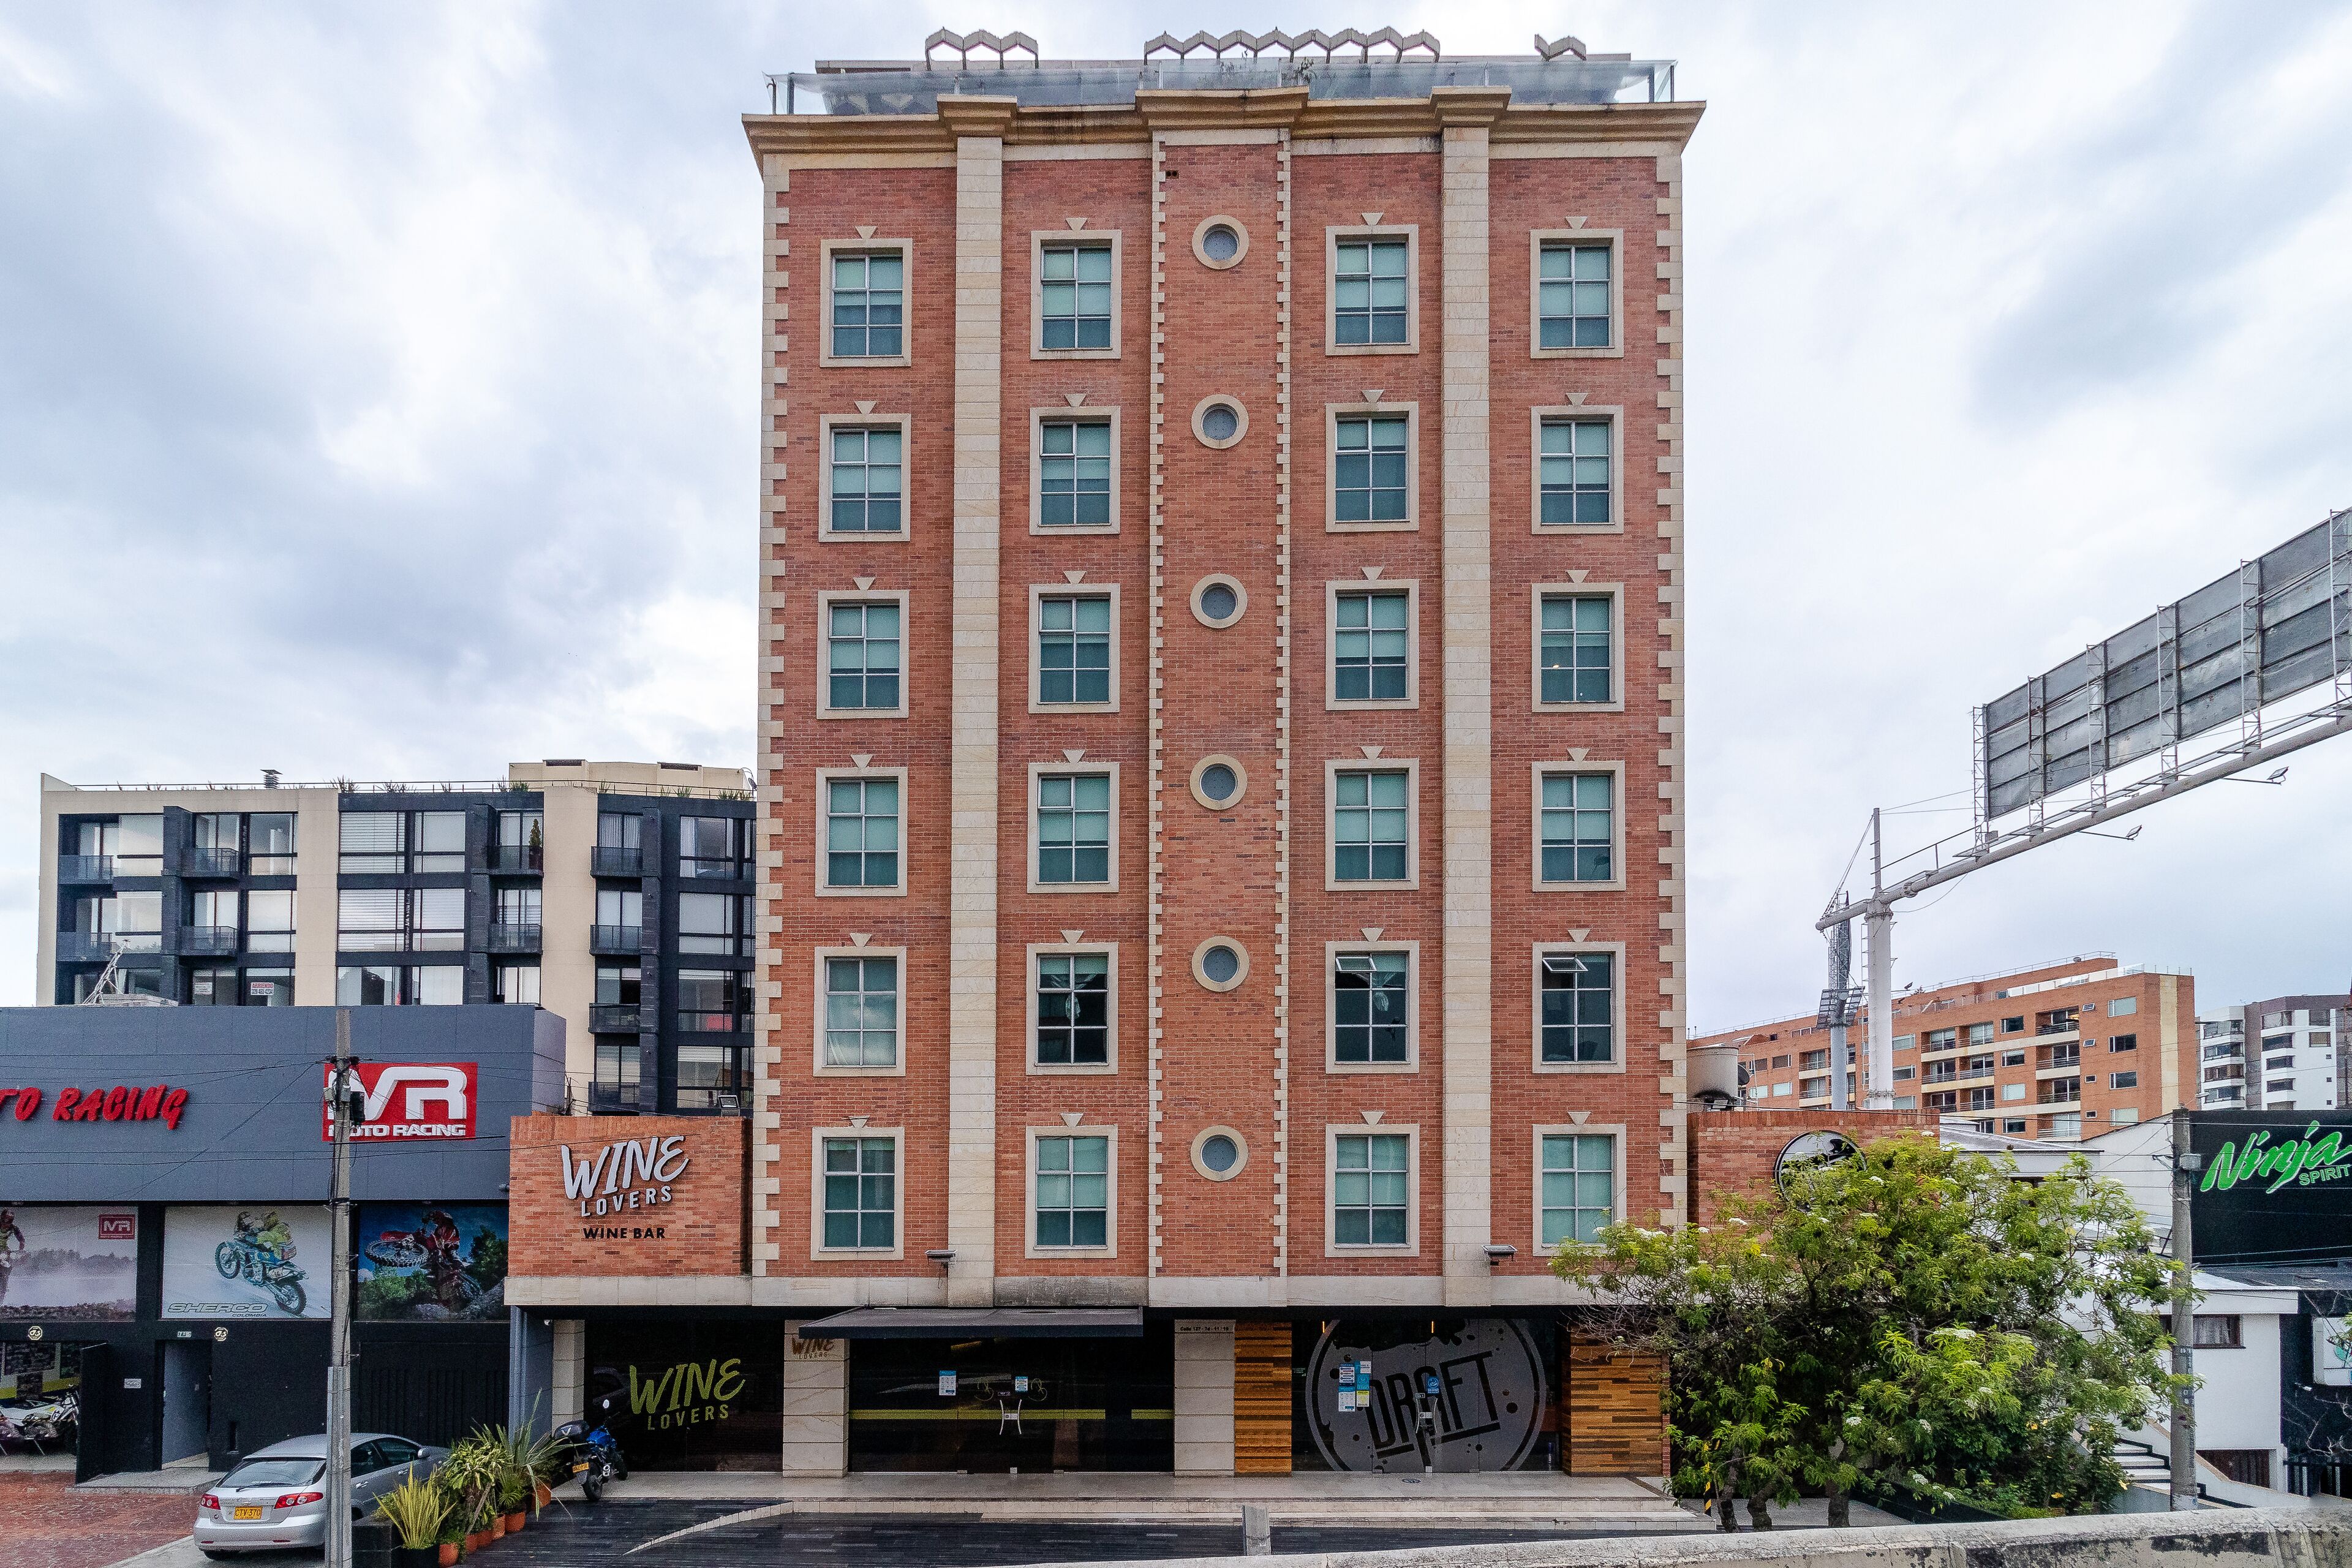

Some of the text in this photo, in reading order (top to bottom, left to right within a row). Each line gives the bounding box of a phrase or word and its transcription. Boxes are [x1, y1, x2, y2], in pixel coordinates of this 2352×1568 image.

[52, 1084, 188, 1130] RACING
[393, 1124, 467, 1136] RACING
[561, 1136, 690, 1199] WINE
[2200, 1120, 2352, 1194] Ninja
[2299, 1164, 2351, 1186] SPIRIT
[581, 1185, 672, 1217] LOVERS
[582, 1227, 666, 1239] WINE BAR
[168, 1303, 268, 1313] SHERCO
[791, 1337, 834, 1355] WINE
[629, 1358, 746, 1414] WINE
[647, 1404, 729, 1430] LOVERS
[1365, 1350, 1499, 1468] DRAFT
